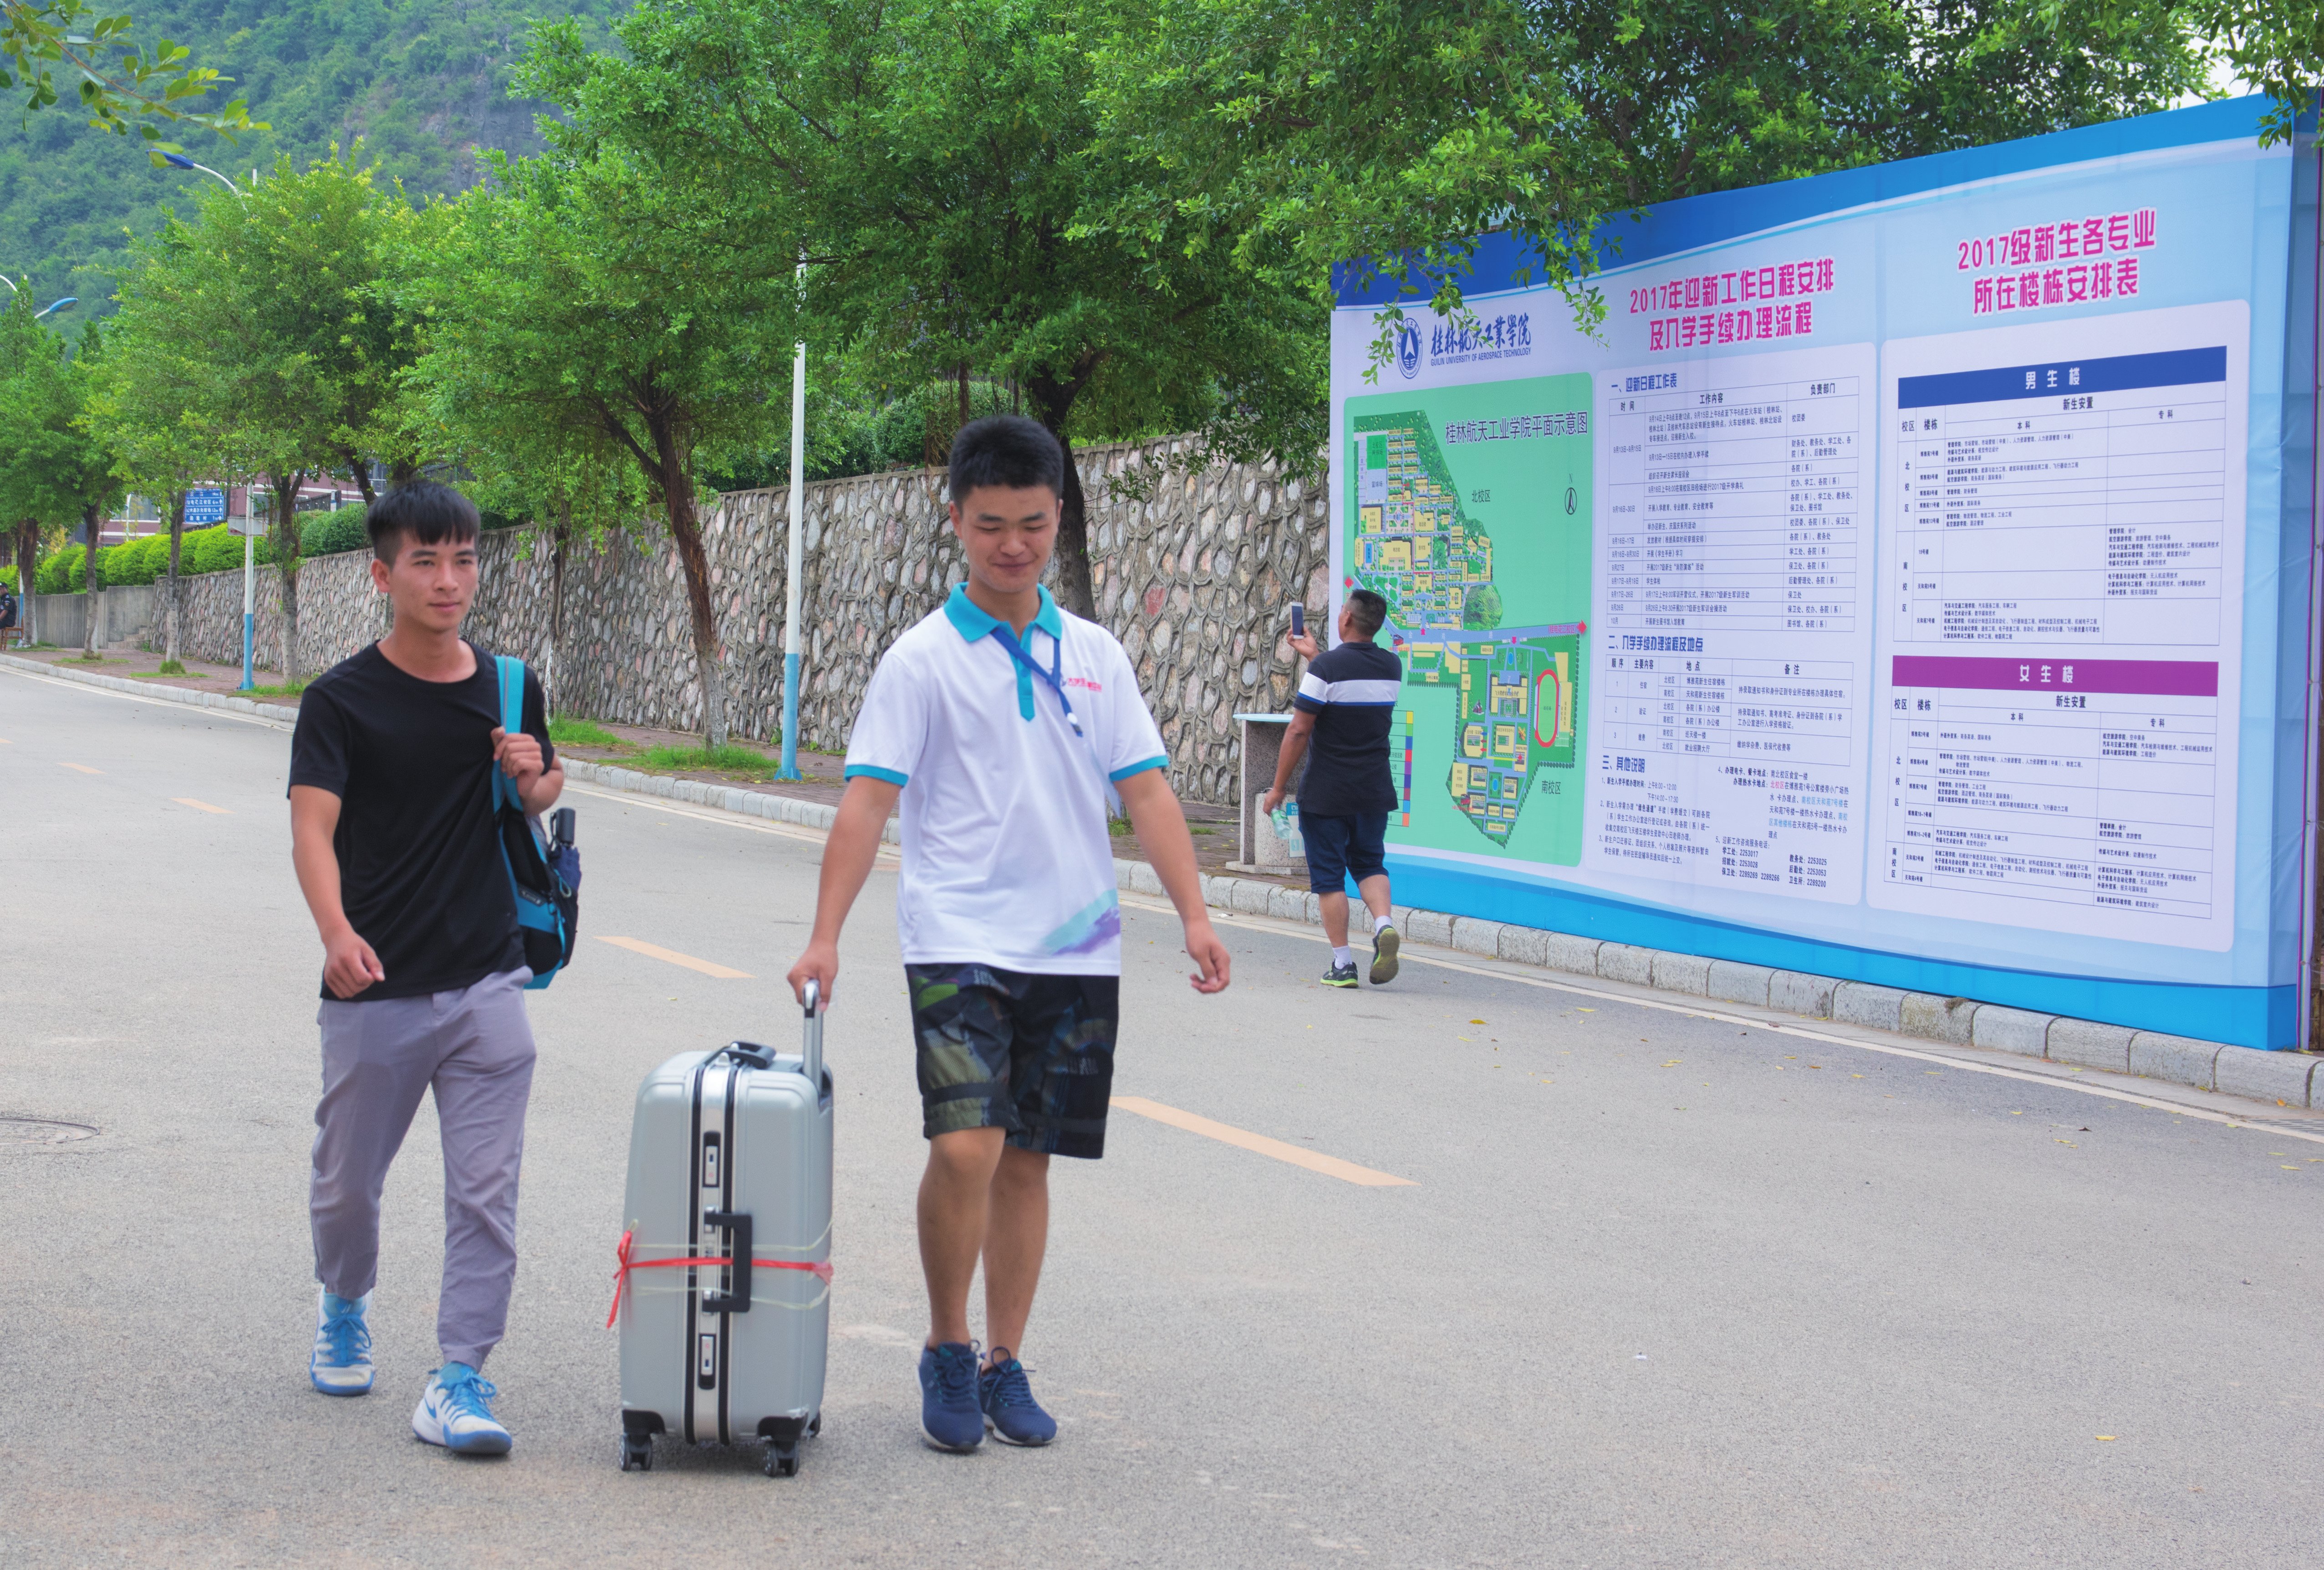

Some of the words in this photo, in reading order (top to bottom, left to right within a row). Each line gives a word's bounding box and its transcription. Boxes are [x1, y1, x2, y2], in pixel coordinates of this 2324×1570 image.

[1957, 209, 2156, 270] 2017级新生各专业
[1630, 258, 1834, 314] 2017年迎新工作日程安排
[1974, 258, 2138, 314] 所在楼栋安排表
[1650, 301, 1812, 351] 及入学手续办理流程
[1431, 357, 1444, 366] GUILIN
[1446, 355, 1470, 364] UNIVERSITY
[1479, 351, 1502, 361] AEROSPACE
[1504, 347, 1530, 357] TECHNOLOGY
[1611, 373, 1677, 392] 一、迎新日程工作表
[2025, 367, 2080, 390] 男生楼
[1811, 383, 1835, 395] 负责部门
[1700, 393, 1723, 404] 工作内容
[2063, 397, 2093, 410] 新生安置
[1792, 413, 1805, 422] 校团委
[1924, 418, 1937, 430] 楼栋
[1446, 411, 1588, 445] 桂林航天工业学院平面示意图
[1902, 421, 1915, 432] 校区
[1792, 464, 1812, 472] 各院（系）
[1569, 474, 1573, 484] N
[1472, 489, 1490, 503] 北校区
[1790, 503, 1822, 512] 保卫处、图书馆
[1789, 547, 1829, 556] 学工处、各院（系）
[1789, 562, 1829, 570] 保卫处、各院（系）
[1609, 636, 1703, 652] 二、入学手续办理流程及地点
[1634, 659, 1653, 669] 主要内容
[2019, 664, 2073, 683] 女生楼
[1894, 698, 1907, 710] 校区
[1917, 699, 1931, 711] 楼栋
[2056, 695, 2086, 708] 新生安置
[1602, 755, 1645, 773] 三、其他说明
[1542, 781, 1561, 795] 南校区
[1761, 873, 1779, 882] 2289266
